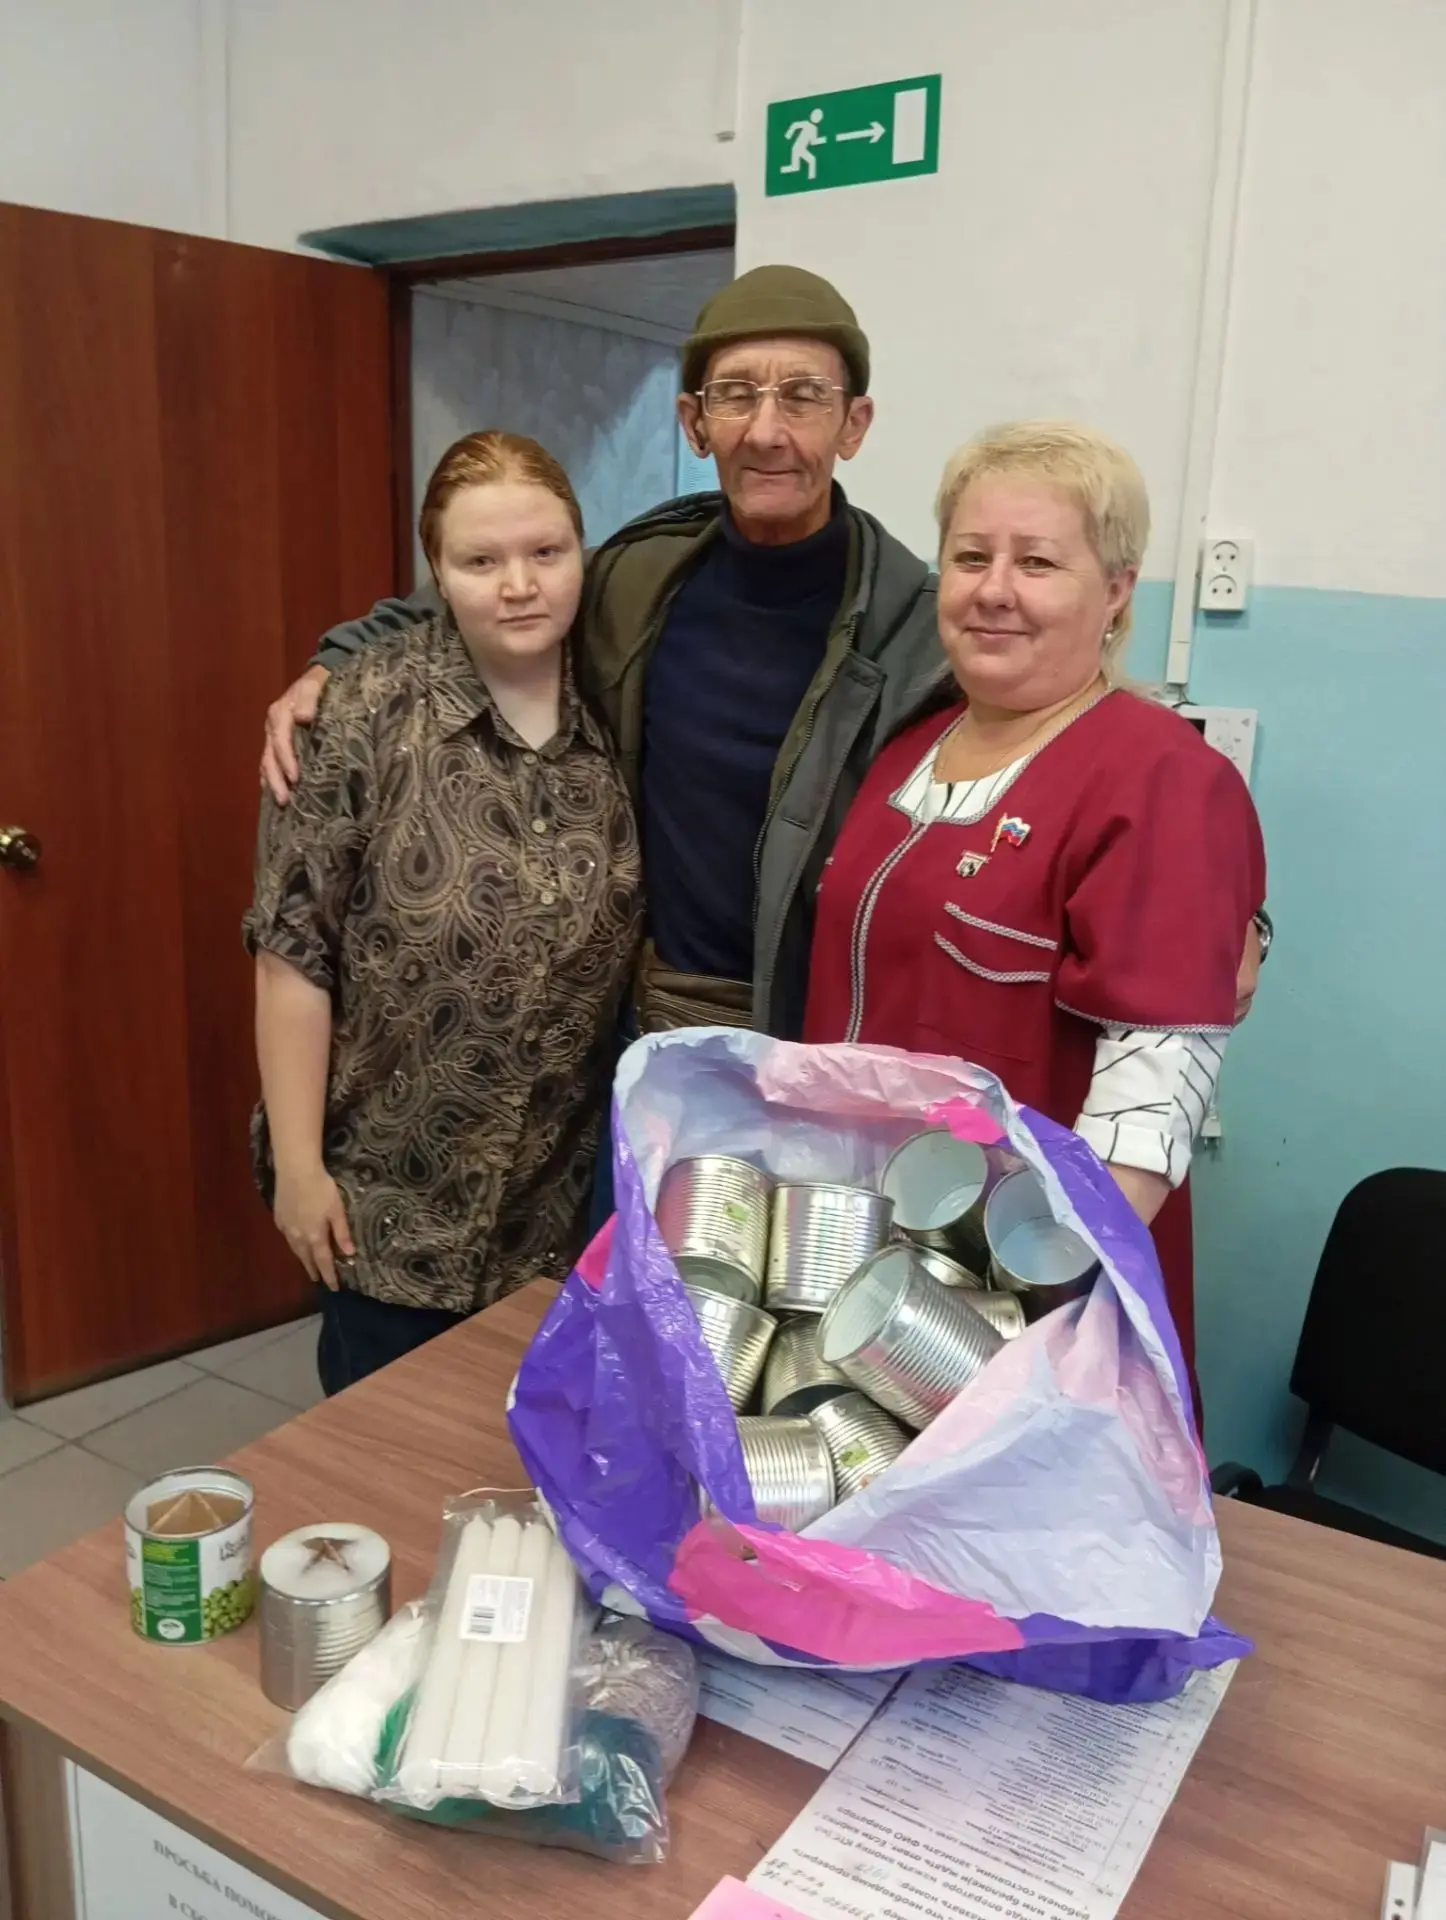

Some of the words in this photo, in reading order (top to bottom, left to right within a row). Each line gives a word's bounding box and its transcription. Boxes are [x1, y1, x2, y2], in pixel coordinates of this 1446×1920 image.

[859, 1830, 887, 1847] Если
[892, 1830, 921, 1848] ФИО
[790, 1846, 851, 1878] проверить
[853, 1841, 895, 1865] кнопку
[920, 1843, 971, 1870] записать
[850, 1873, 924, 1912] необходимо
[971, 1864, 1036, 1897] состоянии,
[939, 1899, 981, 1920] азвать
[940, 1880, 1003, 1912] оператора
